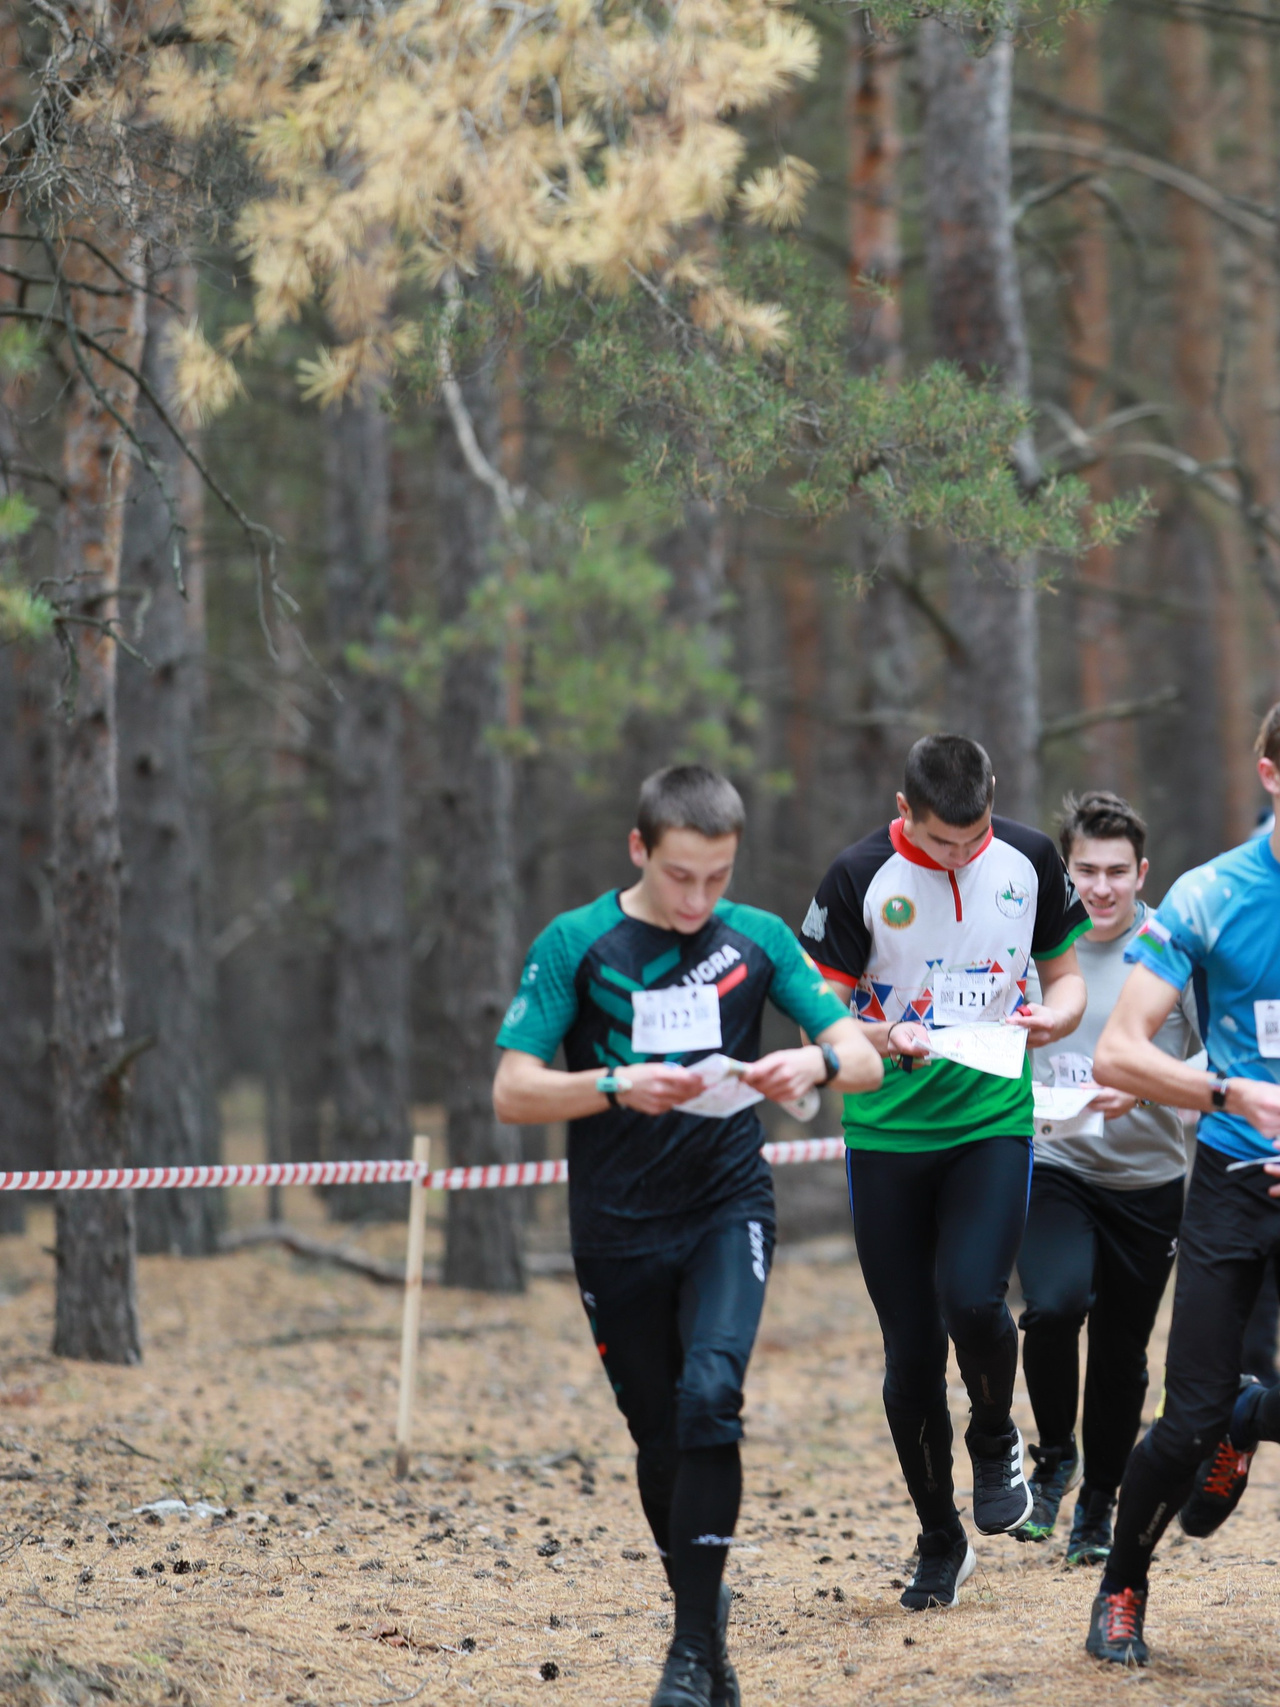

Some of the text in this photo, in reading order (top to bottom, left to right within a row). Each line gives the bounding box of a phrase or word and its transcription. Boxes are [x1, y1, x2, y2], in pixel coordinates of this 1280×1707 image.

[959, 991, 986, 1006] 121
[661, 1009, 690, 1030] 122
[1071, 1068, 1088, 1083] 12
